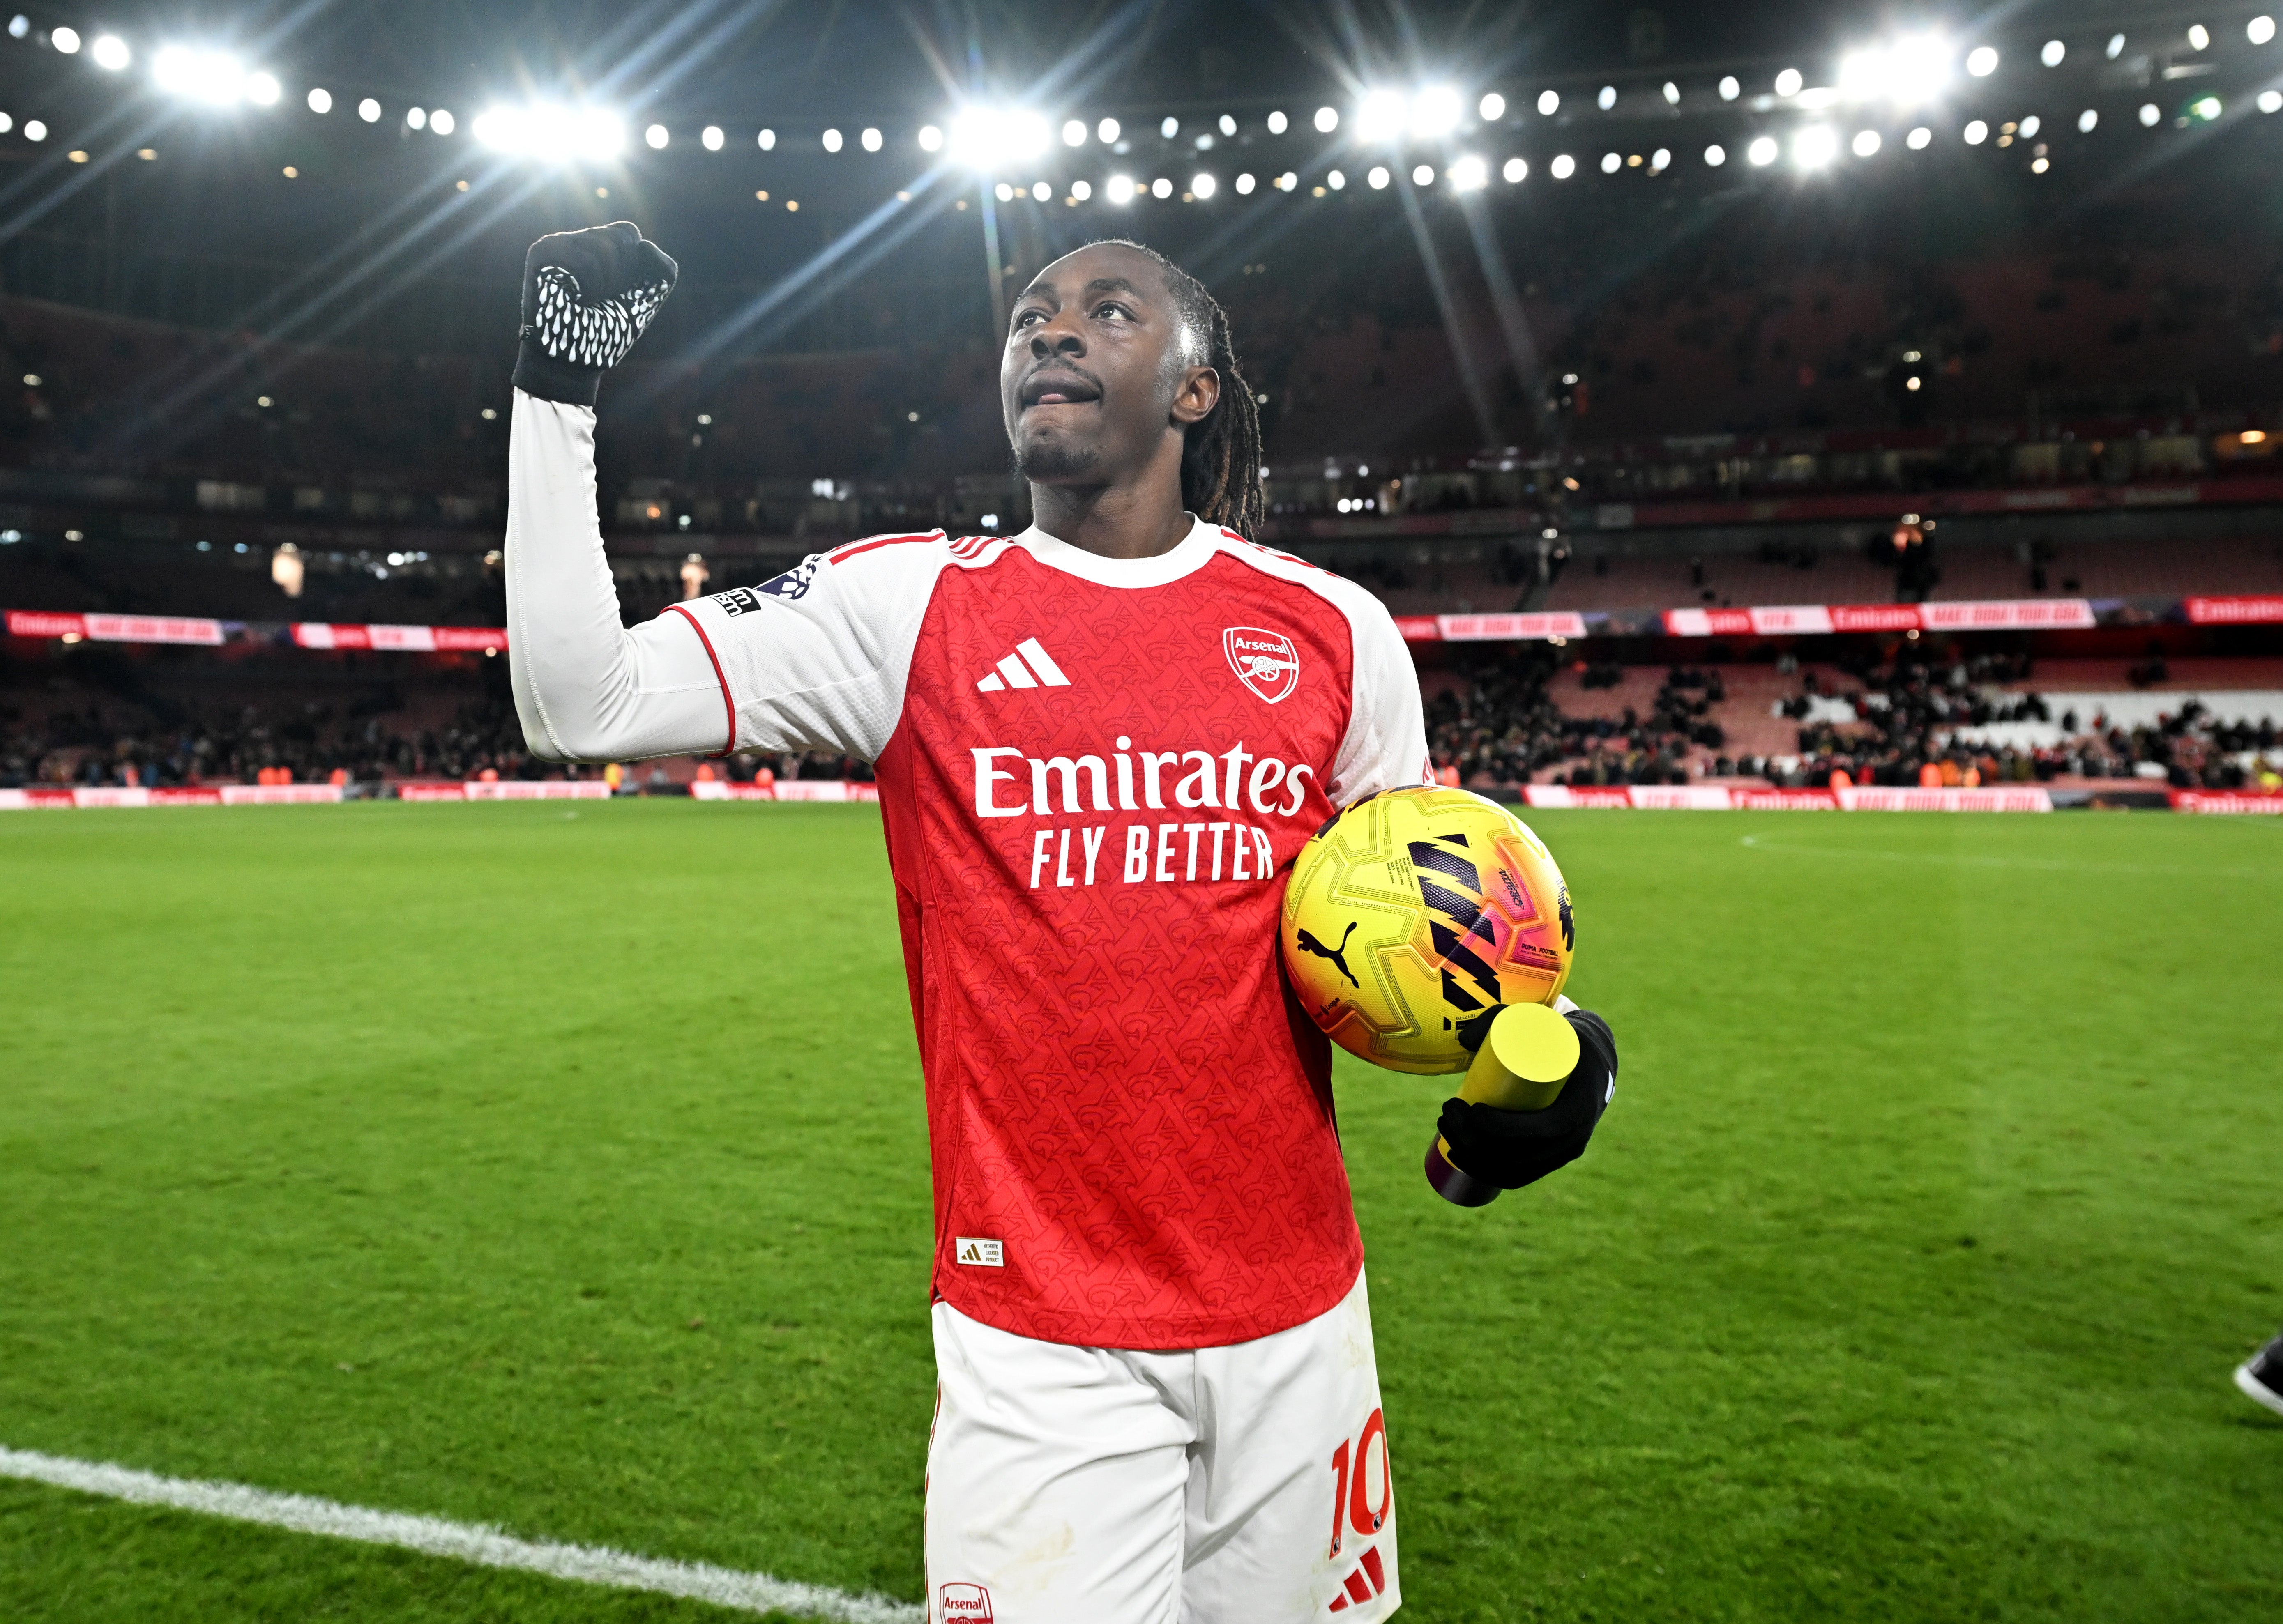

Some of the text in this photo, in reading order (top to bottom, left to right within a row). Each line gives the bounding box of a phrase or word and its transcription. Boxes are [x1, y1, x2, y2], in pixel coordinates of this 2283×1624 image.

[1235, 637, 1288, 655] Arsenal
[969, 735, 1314, 818] Emirates
[1030, 826, 1106, 889] FLY
[1124, 821, 1274, 883] BETTER
[1522, 943, 1536, 952] PUMA
[1539, 947, 1558, 957] FOOTBALL
[1329, 1408, 1391, 1561] 10
[945, 1597, 982, 1610] Arsenal
